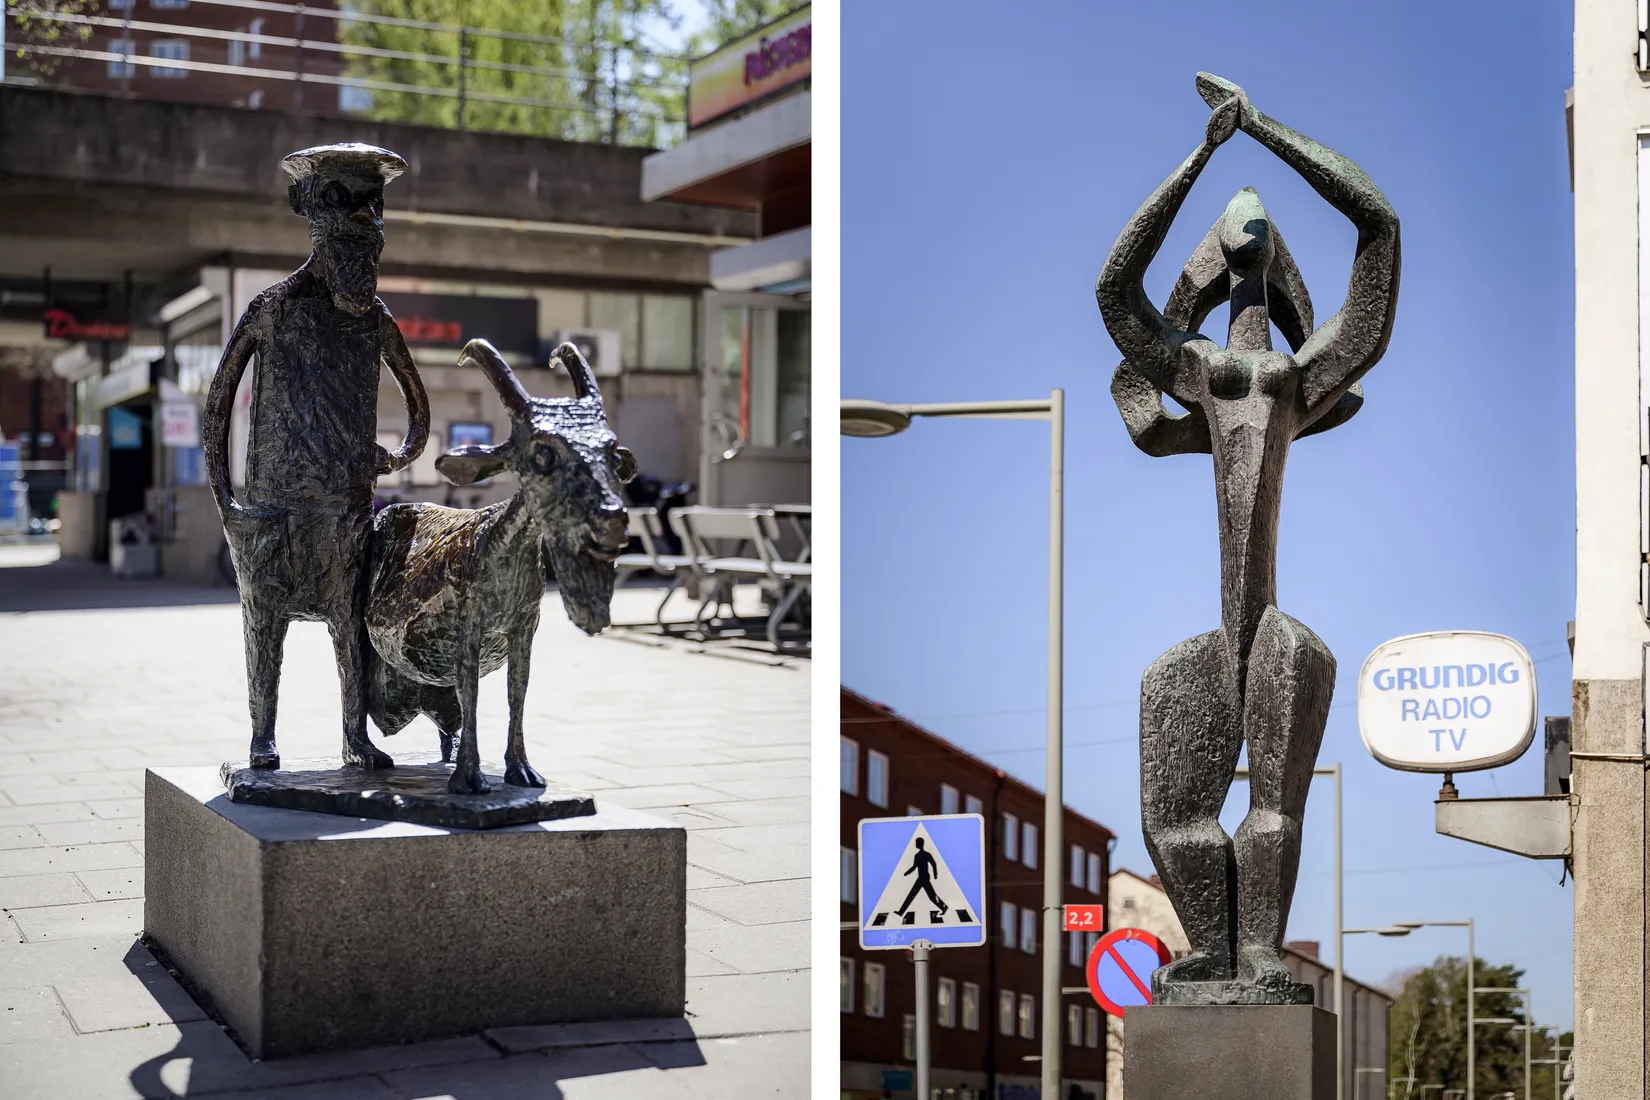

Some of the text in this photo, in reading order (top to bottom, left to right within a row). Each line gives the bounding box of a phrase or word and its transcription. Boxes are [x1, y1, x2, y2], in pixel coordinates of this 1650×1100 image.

[1373, 661, 1519, 691] GRUNDIG
[1402, 695, 1491, 721] RADIO
[1428, 728, 1467, 752] TV
[1069, 911, 1094, 927] 2,2
